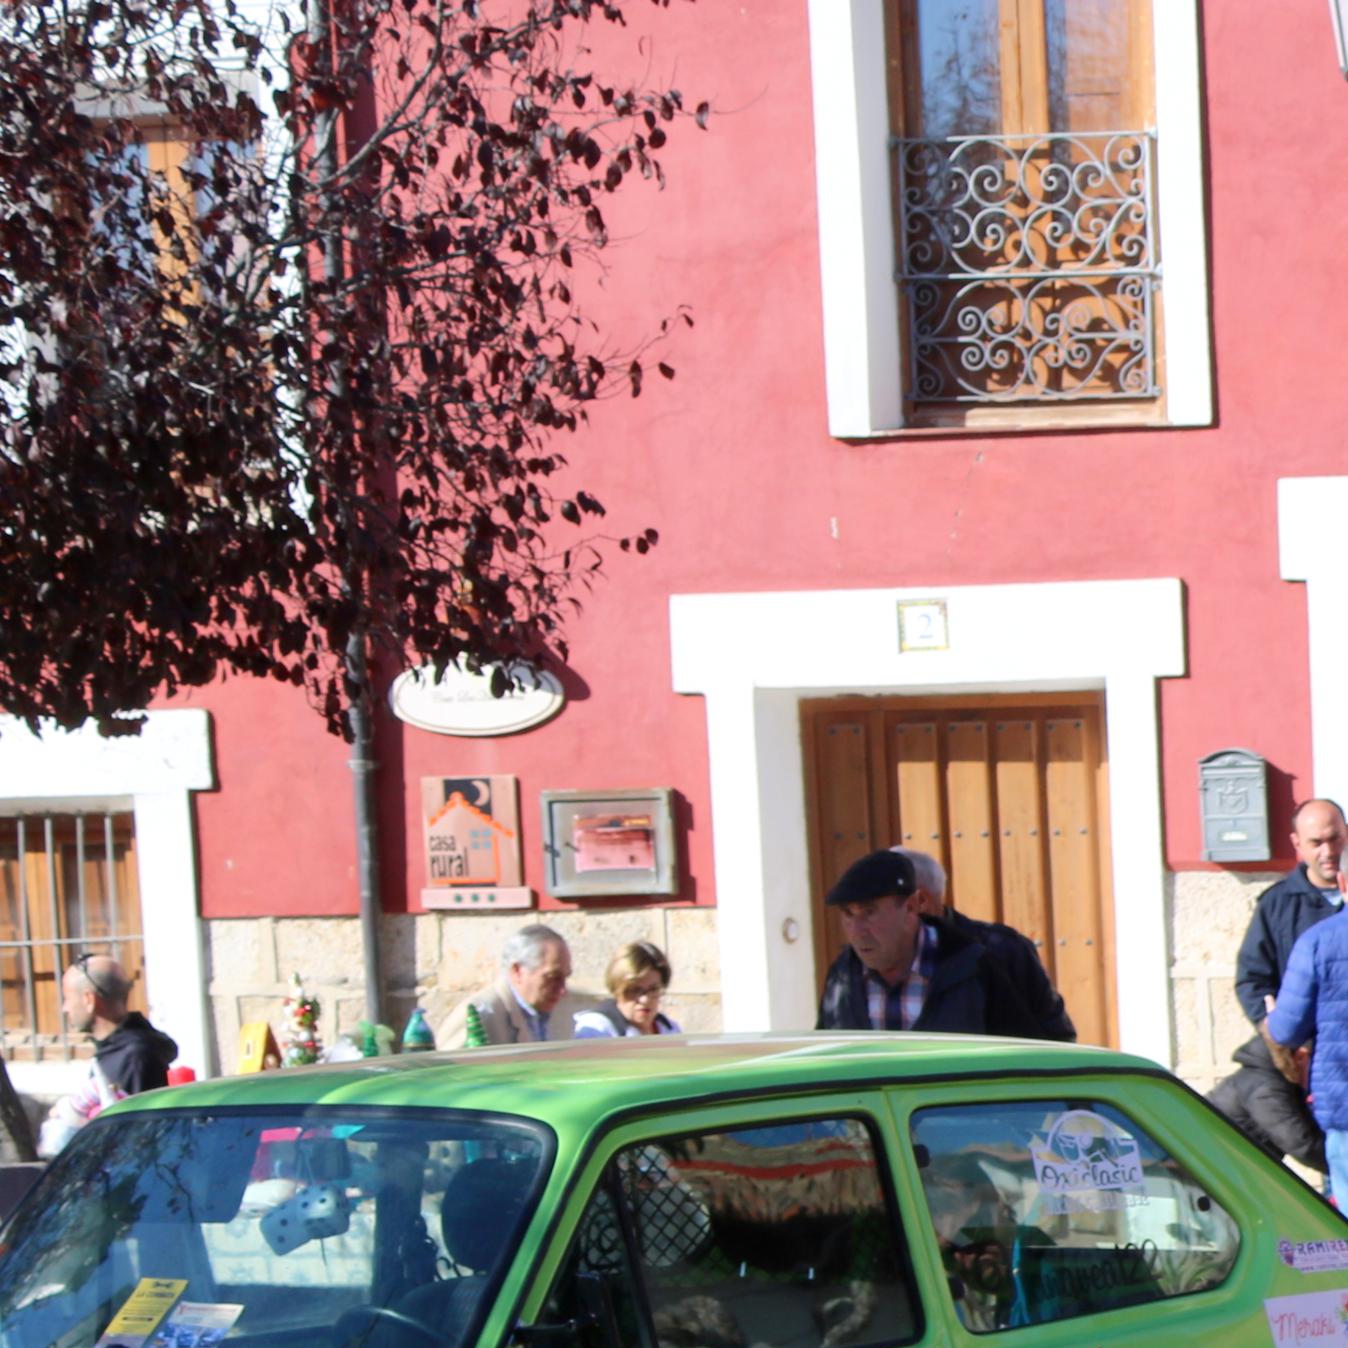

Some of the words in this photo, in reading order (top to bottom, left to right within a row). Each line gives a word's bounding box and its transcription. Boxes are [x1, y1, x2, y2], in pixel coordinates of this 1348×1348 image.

[918, 613, 934, 639] 2
[429, 834, 457, 852] casa
[430, 847, 469, 878] rural
[1272, 1311, 1336, 1345] Meraki
